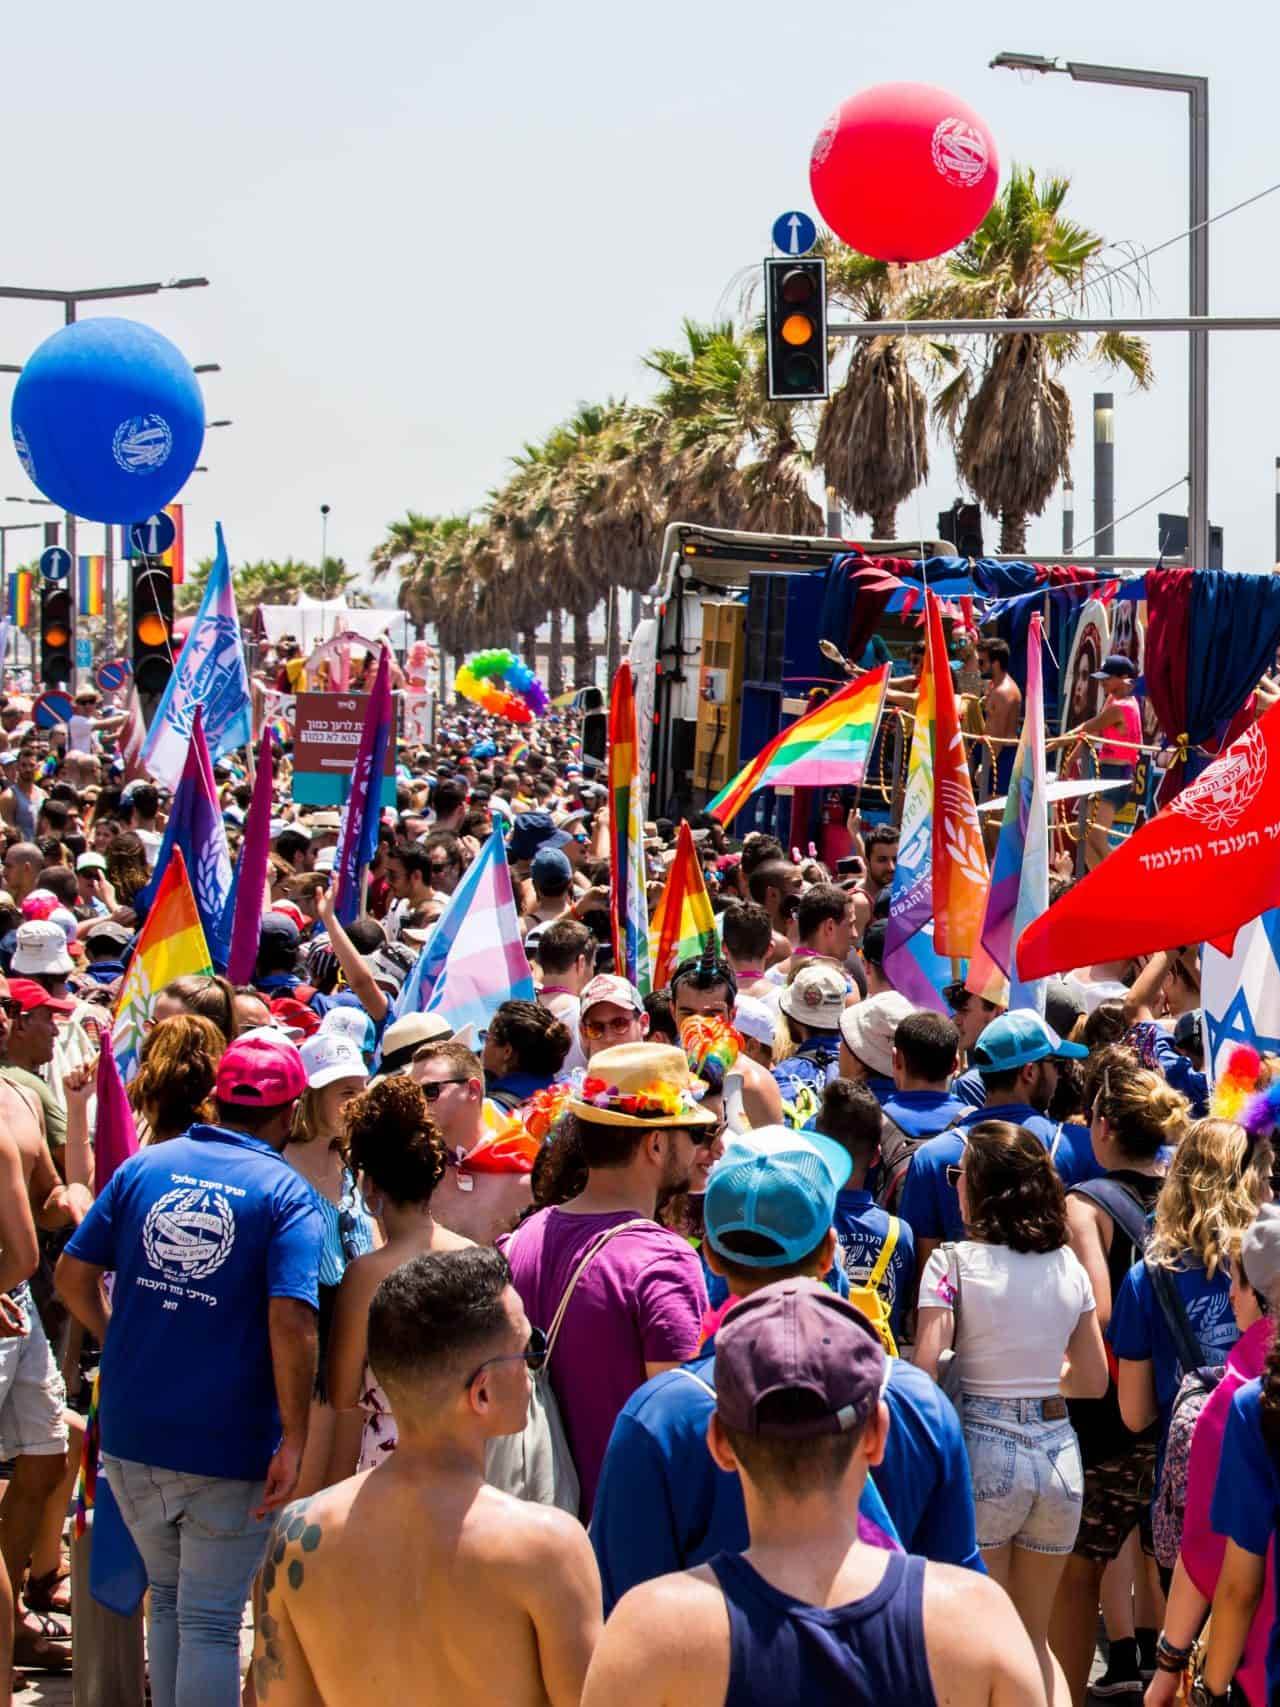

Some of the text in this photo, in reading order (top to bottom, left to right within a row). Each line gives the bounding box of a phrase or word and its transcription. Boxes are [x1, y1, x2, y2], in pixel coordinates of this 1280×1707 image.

[1138, 843, 1203, 870] והלומד
[1207, 830, 1260, 857] העובד
[850, 1233, 883, 1246] העובד
